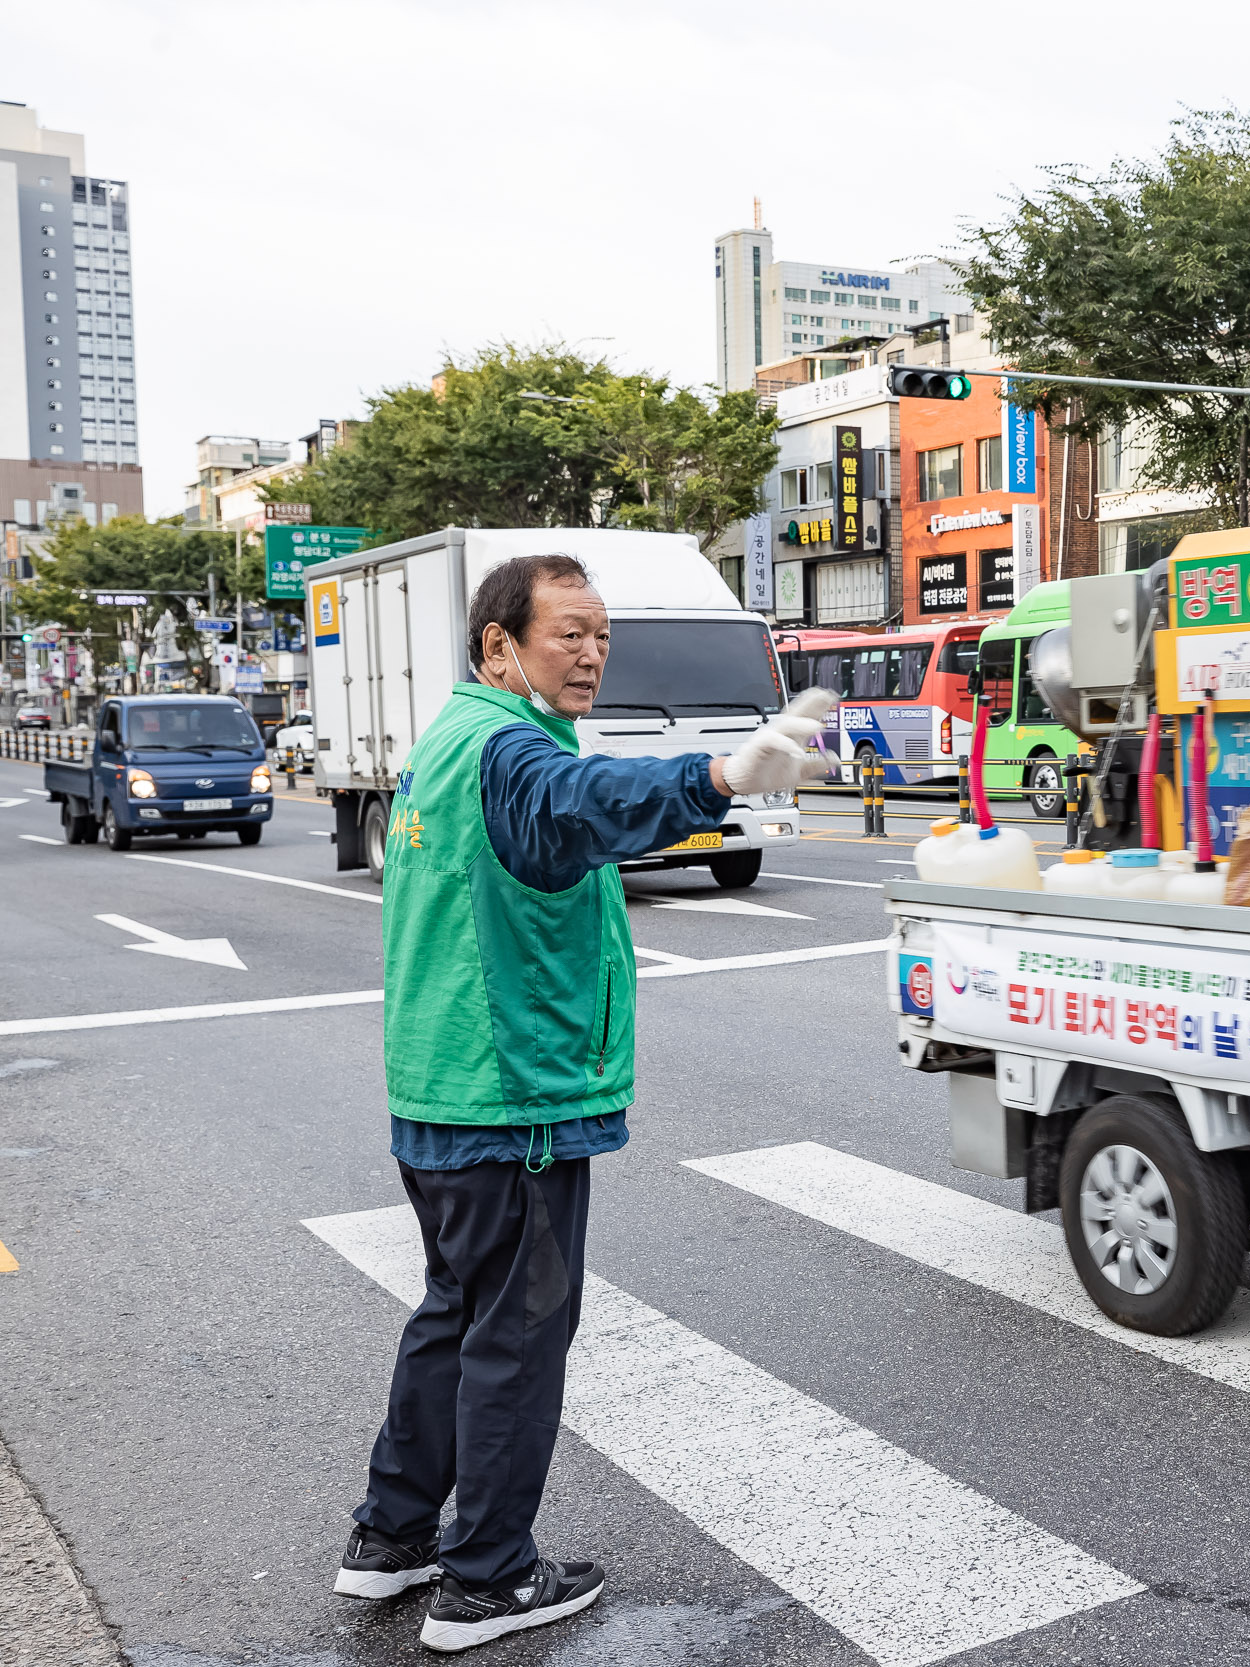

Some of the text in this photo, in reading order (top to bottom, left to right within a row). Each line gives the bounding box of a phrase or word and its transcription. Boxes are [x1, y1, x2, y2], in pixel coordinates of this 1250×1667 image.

[821, 270, 890, 291] HANRIM
[1016, 458, 1029, 485] box
[841, 457, 858, 533] 쌈바플스
[845, 536, 857, 544] 2F
[754, 535, 765, 597] 공간네일
[1178, 563, 1242, 620] 방역
[844, 708, 873, 729] 공공버스
[691, 835, 718, 847] 6002
[1007, 983, 1056, 1032] 모기
[1063, 991, 1117, 1041] 퇴치
[1125, 998, 1205, 1054] 방역의
